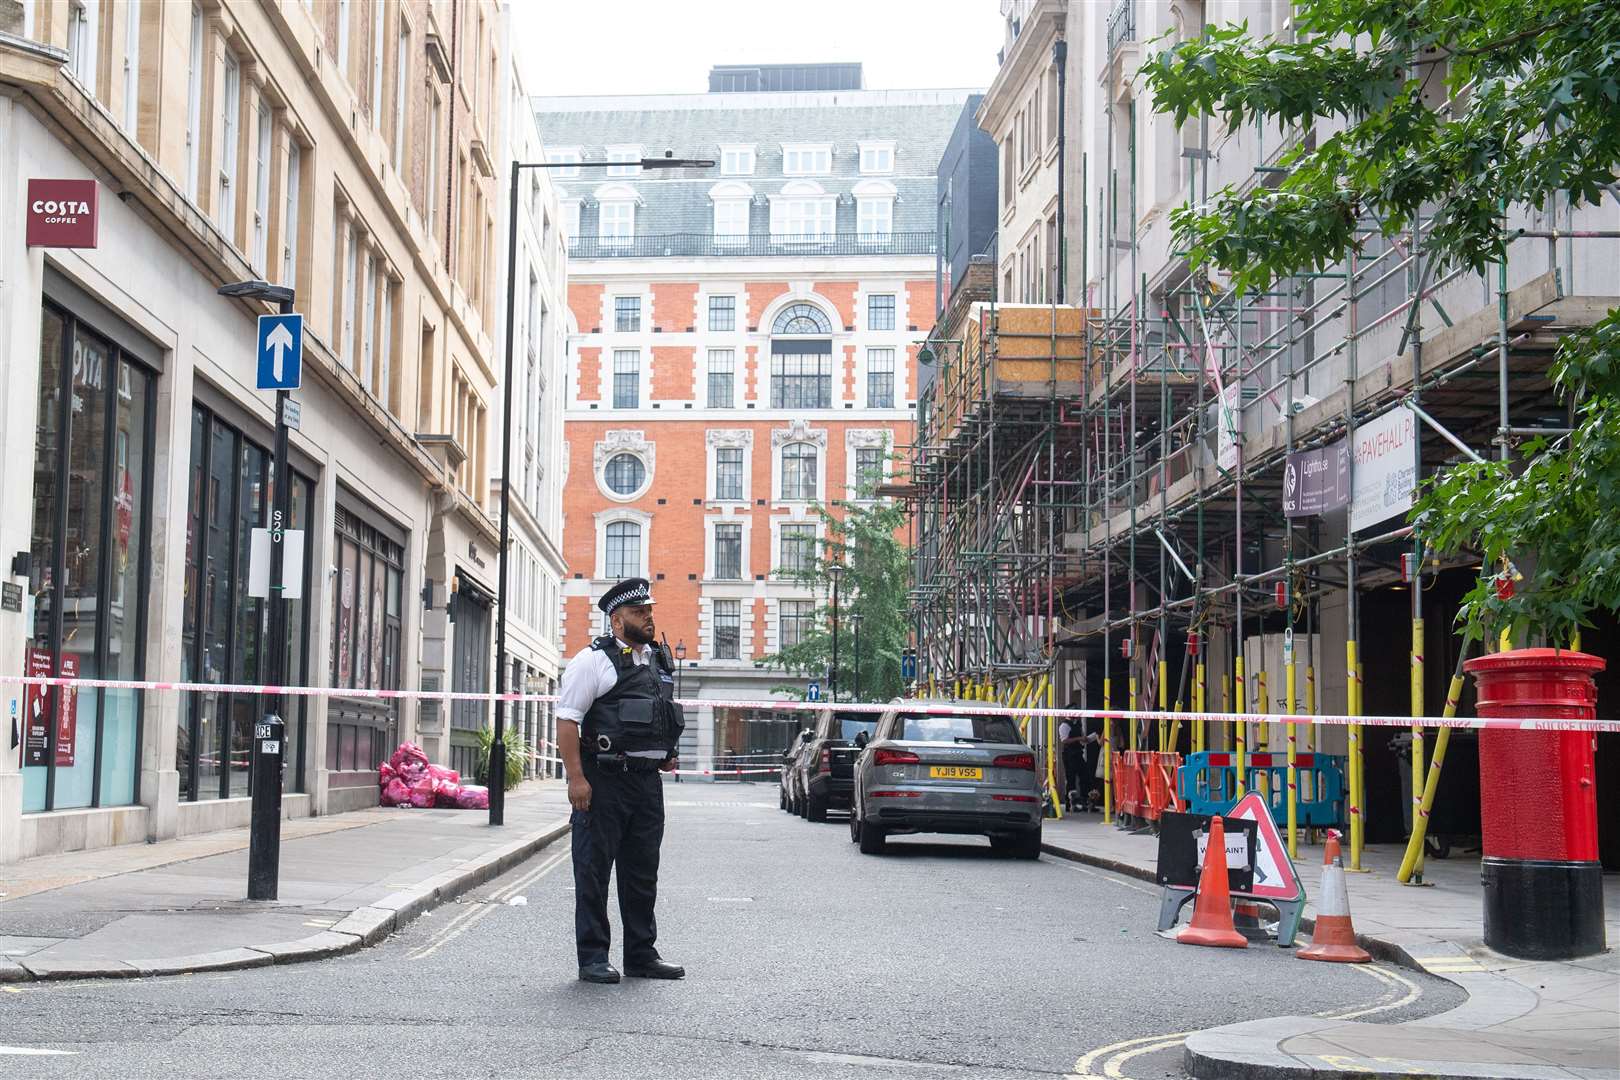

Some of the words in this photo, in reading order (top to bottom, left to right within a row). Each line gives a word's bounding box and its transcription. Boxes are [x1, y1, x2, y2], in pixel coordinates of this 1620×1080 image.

[33, 201, 90, 217] COSTA
[45, 217, 77, 225] COFFEE
[1362, 427, 1403, 465] PAVEHALL
[936, 768, 956, 777] YJ19
[959, 768, 977, 777] VSS
